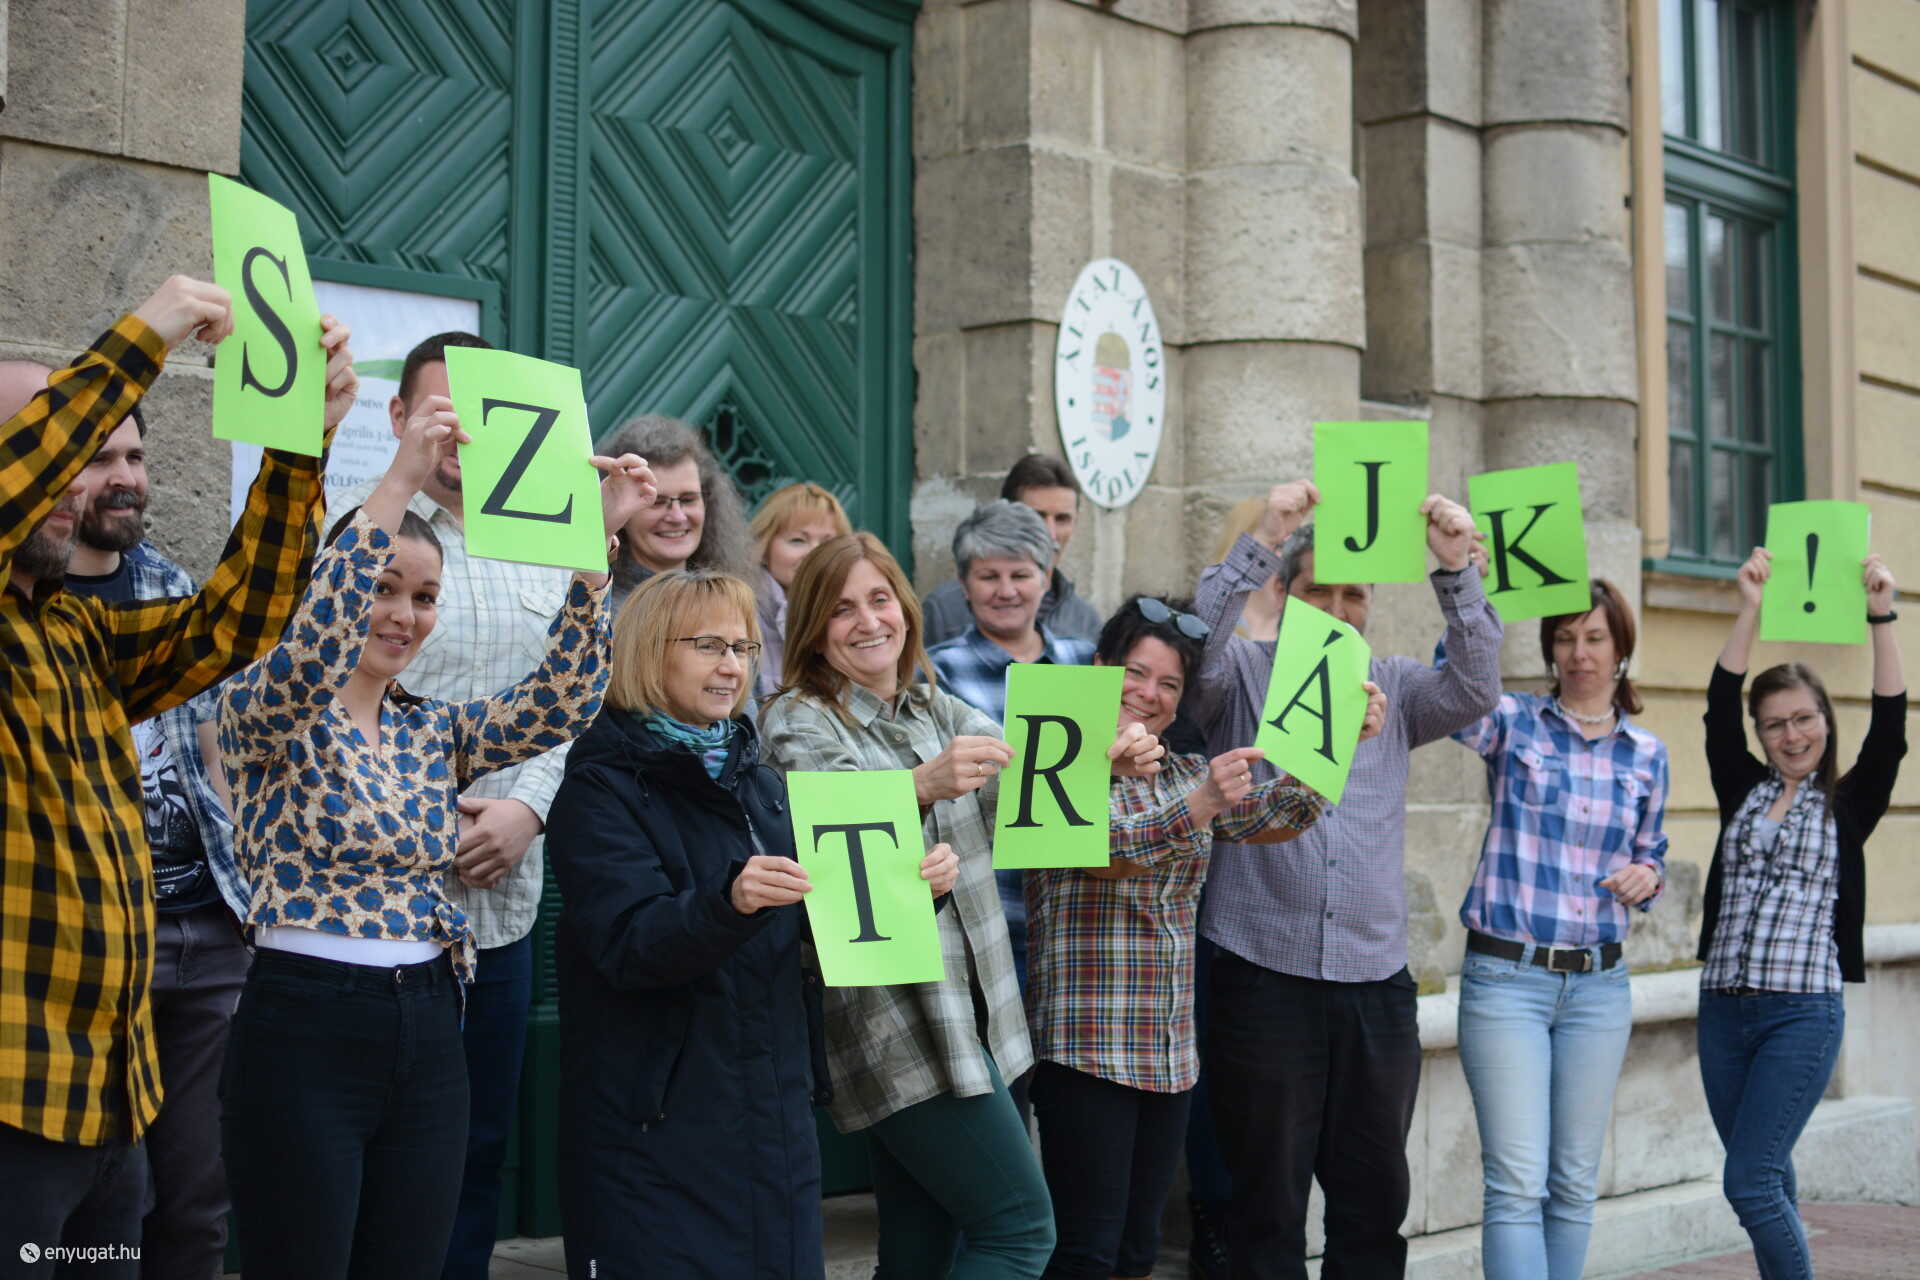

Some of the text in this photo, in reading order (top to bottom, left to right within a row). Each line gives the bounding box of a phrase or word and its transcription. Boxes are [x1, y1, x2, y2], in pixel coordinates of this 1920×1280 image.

[241, 246, 298, 398] S
[480, 397, 574, 525] Z
[1343, 461, 1392, 553] J
[1479, 502, 1577, 595] K
[1803, 532, 1820, 614] !
[1267, 630, 1343, 767] Á
[1004, 714, 1095, 829] R
[812, 821, 900, 943] T
